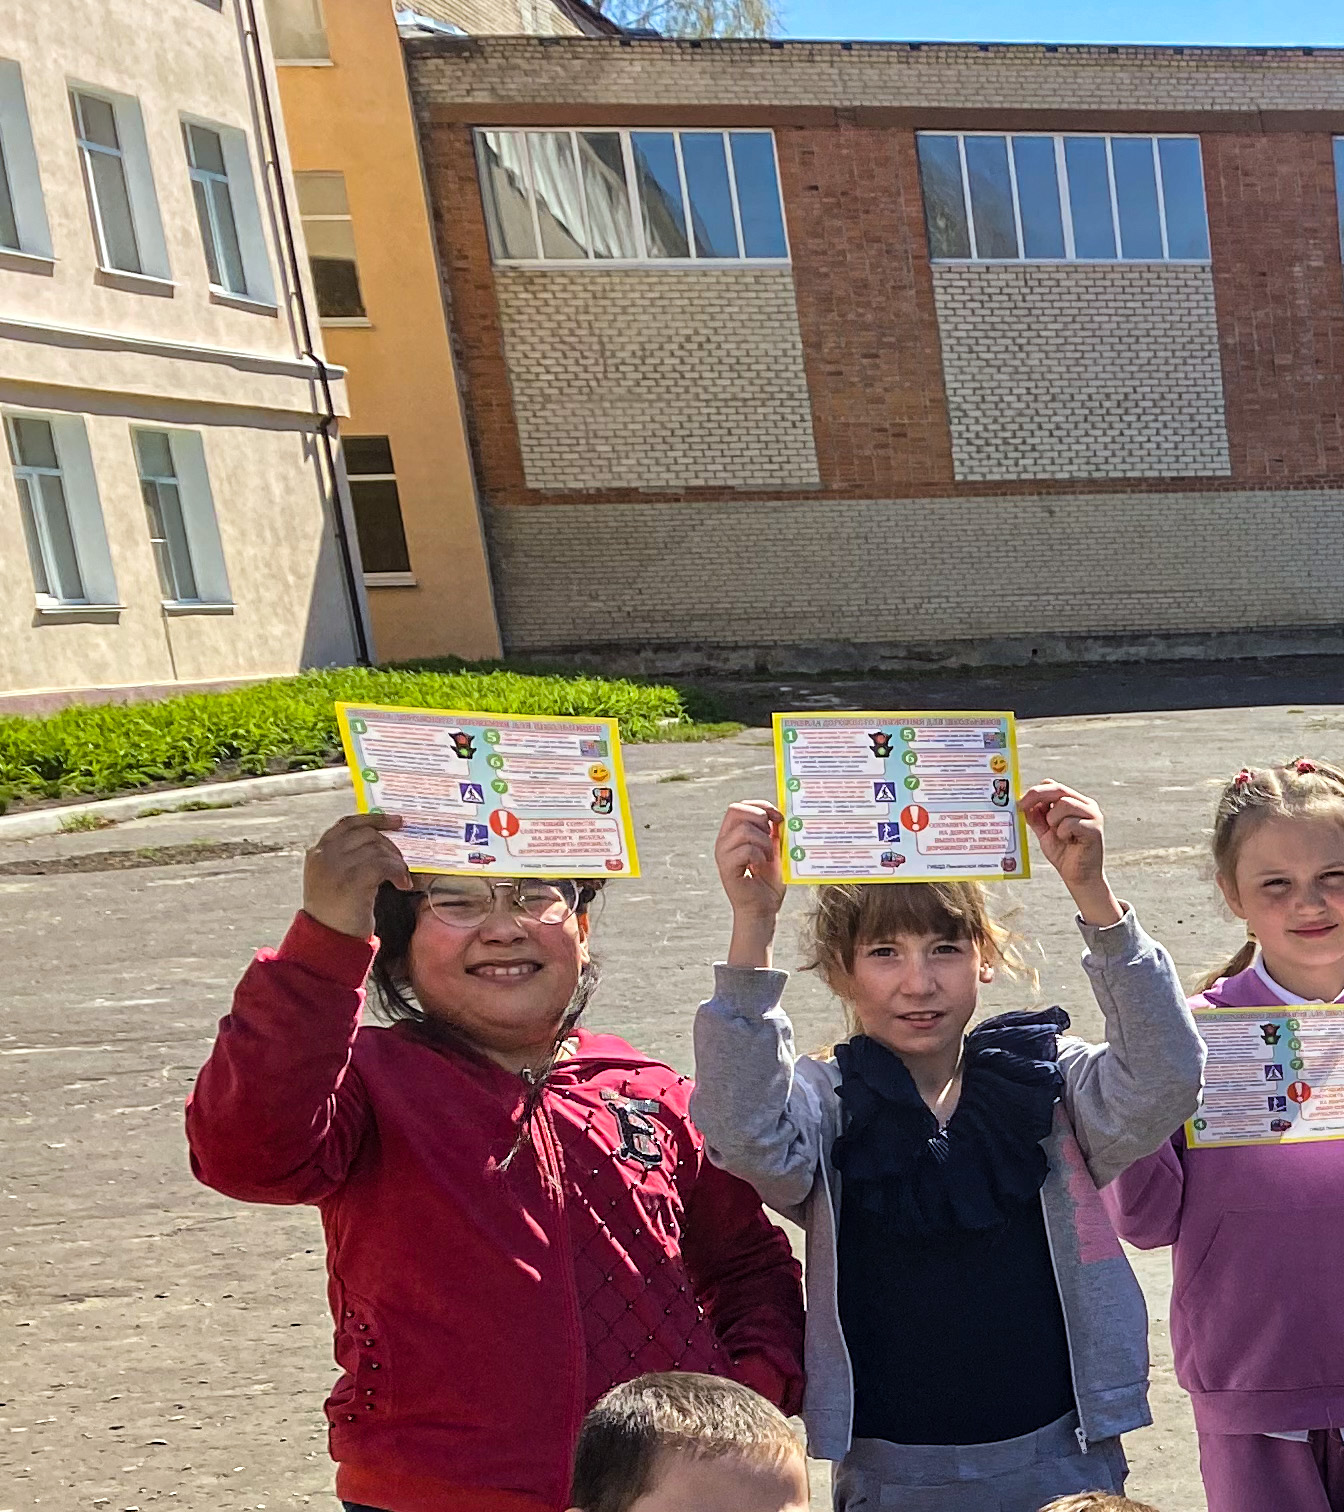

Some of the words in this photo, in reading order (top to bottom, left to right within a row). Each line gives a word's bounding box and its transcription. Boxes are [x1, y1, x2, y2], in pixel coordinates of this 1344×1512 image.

[355, 722, 363, 732] 1
[487, 732, 496, 742] 5
[787, 731, 793, 740] 1
[904, 730, 912, 739] 5
[490, 757, 500, 767] 6
[906, 753, 914, 763] 6
[366, 771, 376, 780] 2
[495, 782, 505, 791] 7
[790, 780, 798, 789] 2
[907, 778, 917, 788] 7
[791, 820, 800, 829] 3
[794, 849, 801, 859] 4
